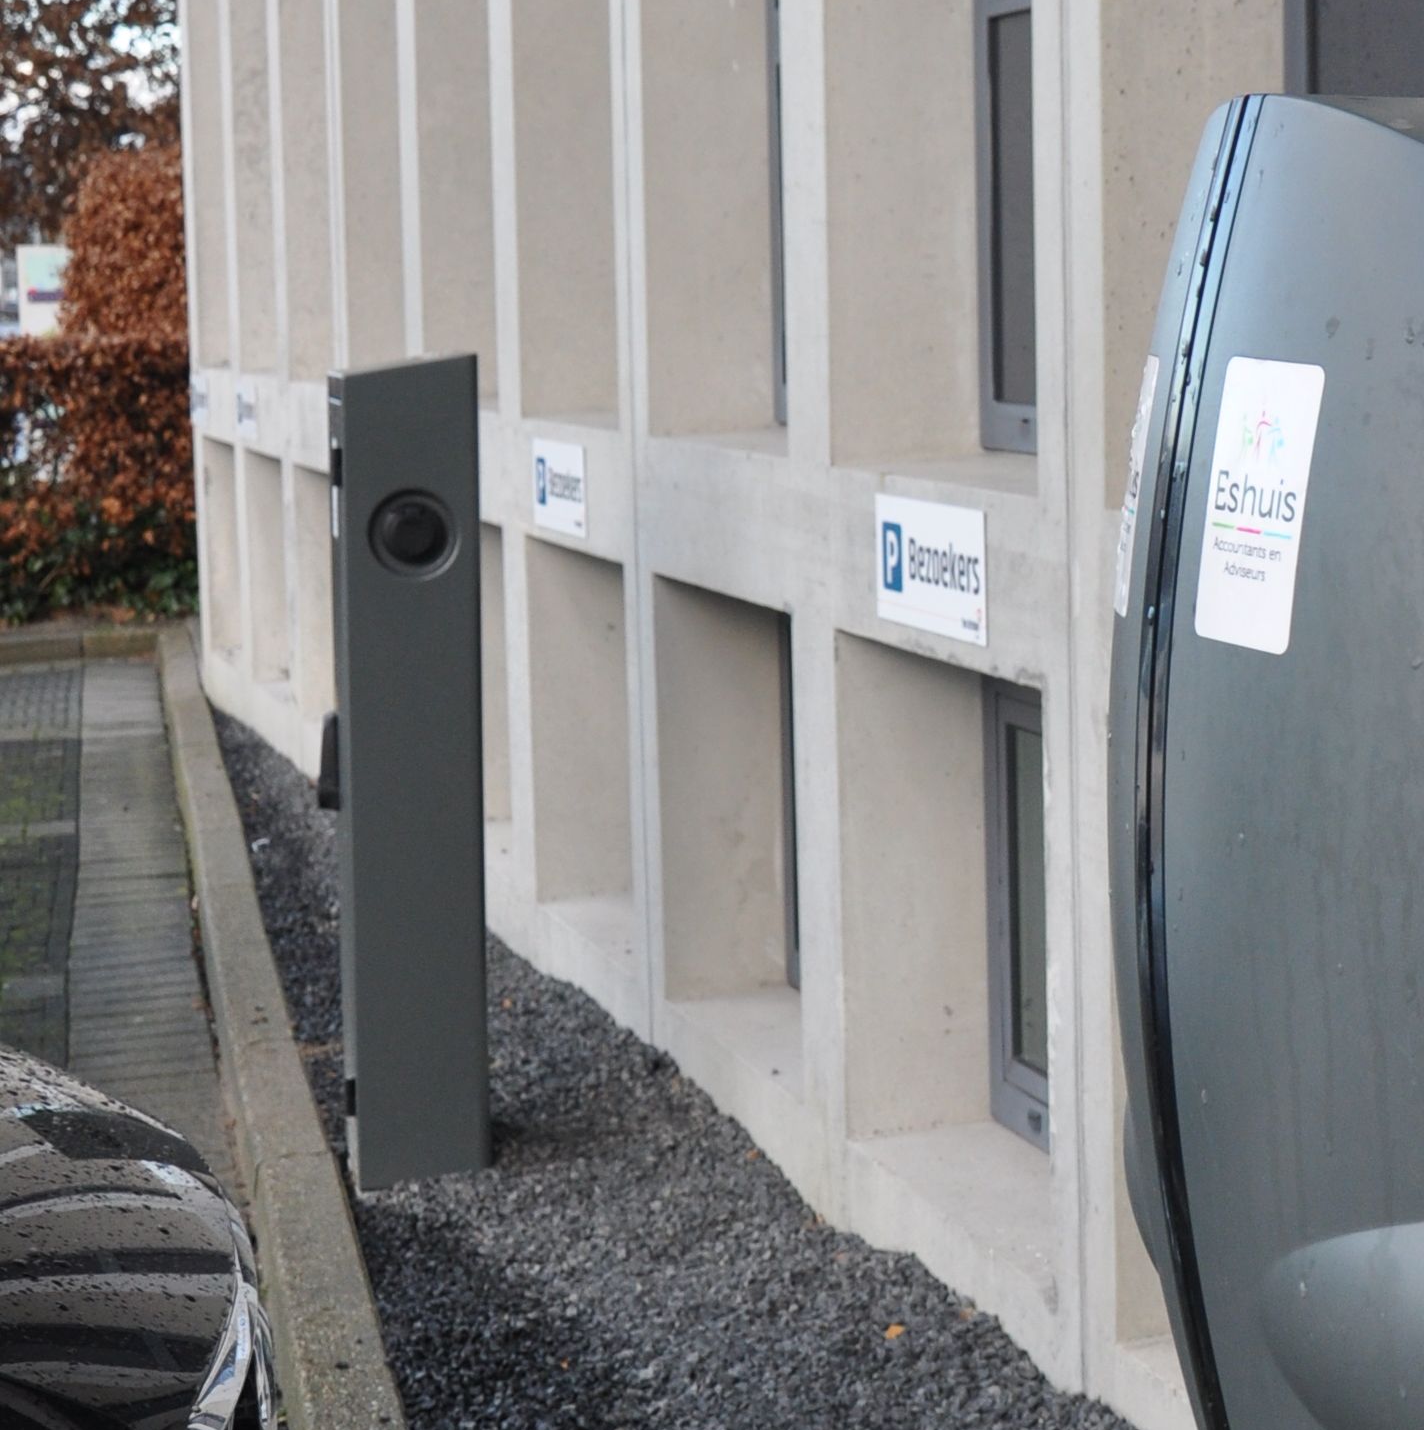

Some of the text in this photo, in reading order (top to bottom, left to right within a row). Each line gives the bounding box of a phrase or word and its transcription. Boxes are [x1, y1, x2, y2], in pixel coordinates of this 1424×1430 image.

[1214, 469, 1297, 523] Eshuis
[908, 537, 980, 595] Bezoekers
[1213, 536, 1282, 562] Accountants en
[1223, 560, 1266, 582] Adviseurs
